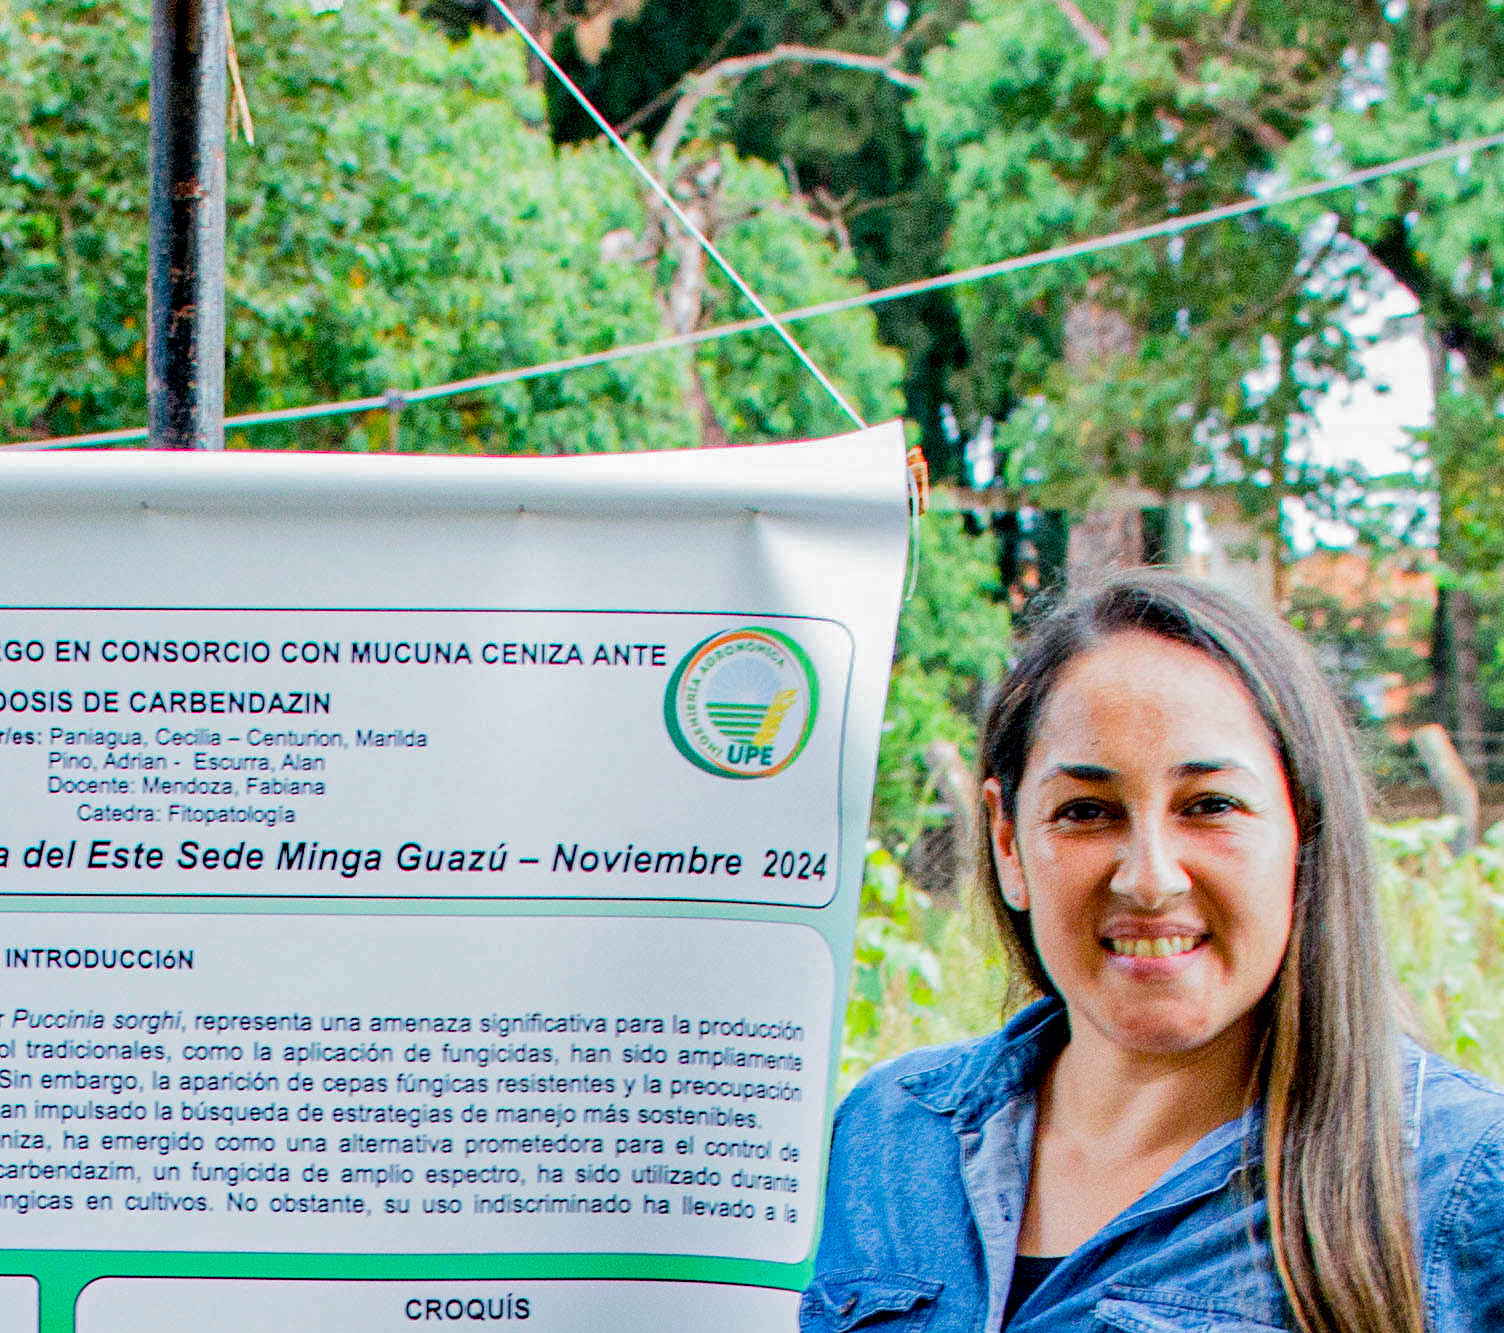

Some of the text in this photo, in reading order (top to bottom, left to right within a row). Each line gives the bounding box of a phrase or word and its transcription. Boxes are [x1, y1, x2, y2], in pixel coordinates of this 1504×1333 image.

[55, 640, 91, 662] EN
[101, 640, 271, 663] CONSORCIO
[280, 641, 340, 664] CON
[351, 641, 473, 664] MUCUNA
[481, 642, 585, 665] CENIZA
[591, 643, 667, 666] ANTE
[82, 691, 120, 713] DE
[128, 690, 331, 714] CARBENDAZIN
[50, 727, 148, 750] Paniagua,
[155, 728, 221, 746] Cecilia
[246, 728, 348, 749] Centurion,
[356, 729, 428, 747] Marilda
[48, 752, 97, 771] Pino,
[102, 752, 167, 770] Adrian
[193, 752, 275, 773] Escurra,
[280, 753, 326, 771] Alan
[727, 744, 774, 766] UPE
[48, 776, 326, 797] Docente: Mendoza, Fabiana
[77, 803, 160, 822] Catedra:
[22, 840, 78, 869] del
[86, 840, 165, 870] Este
[176, 840, 264, 870] Sede
[275, 841, 383, 878] Minga
[396, 841, 508, 872] Guazú
[551, 843, 742, 876] Noviembre
[761, 849, 827, 881] 2024
[11, 1008, 105, 1029] Puccinia
[112, 1010, 186, 1034] sorghi,
[195, 1012, 313, 1035] representa
[321, 1017, 362, 1032] una
[369, 1017, 472, 1032] amenaza
[479, 1012, 608, 1038] significativa
[615, 1017, 665, 1038] para
[672, 1014, 691, 1034] la
[698, 1018, 804, 1041] producción
[34, 1100, 147, 1124] impulsado
[154, 1101, 173, 1120] la
[181, 1101, 290, 1126] búsqueda
[296, 1103, 324, 1122] de
[331, 1104, 454, 1128] estrategias
[460, 1104, 488, 1123] de
[496, 1104, 577, 1128] manejo
[583, 1104, 630, 1123] más
[637, 1106, 762, 1128] sostenibles.
